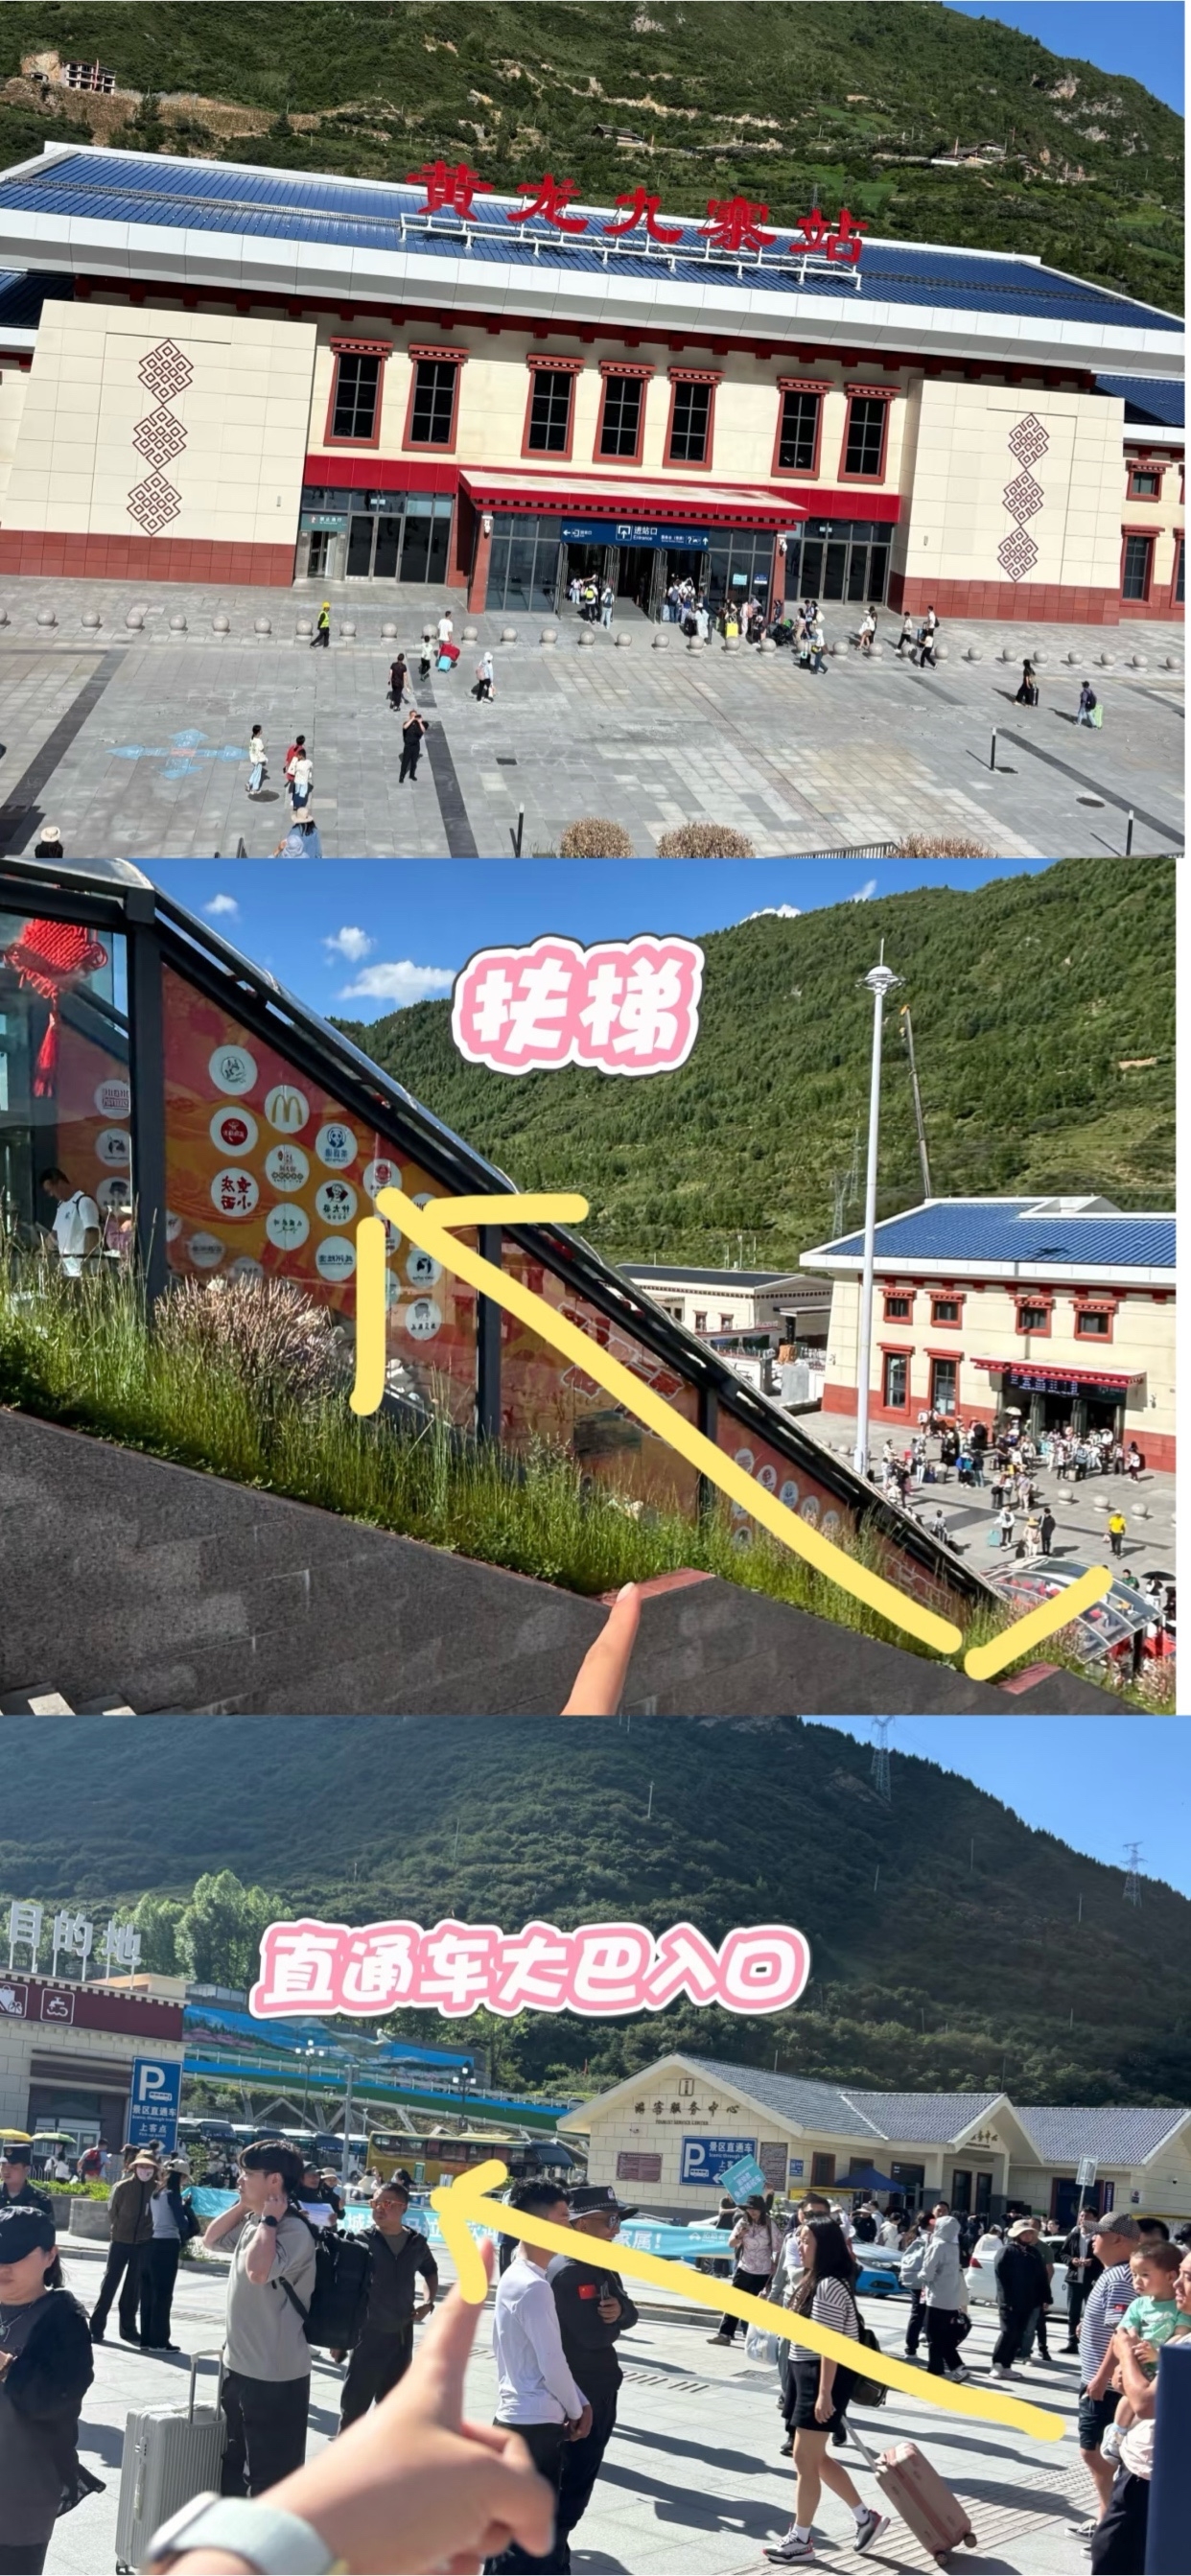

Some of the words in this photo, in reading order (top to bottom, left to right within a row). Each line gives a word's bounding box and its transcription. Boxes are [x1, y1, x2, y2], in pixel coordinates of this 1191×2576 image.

[406, 160, 869, 264] 黄龙九寨站
[634, 527, 658, 535] 进站口
[10, 1901, 142, 1966] 目的地
[139, 2065, 166, 2101] P
[132, 2104, 176, 2117] 景区直通车
[634, 2100, 741, 2118] 游客服务中心
[139, 2122, 167, 2134] 上客点
[709, 2142, 753, 2152] 景区直通车
[683, 2143, 706, 2178] P
